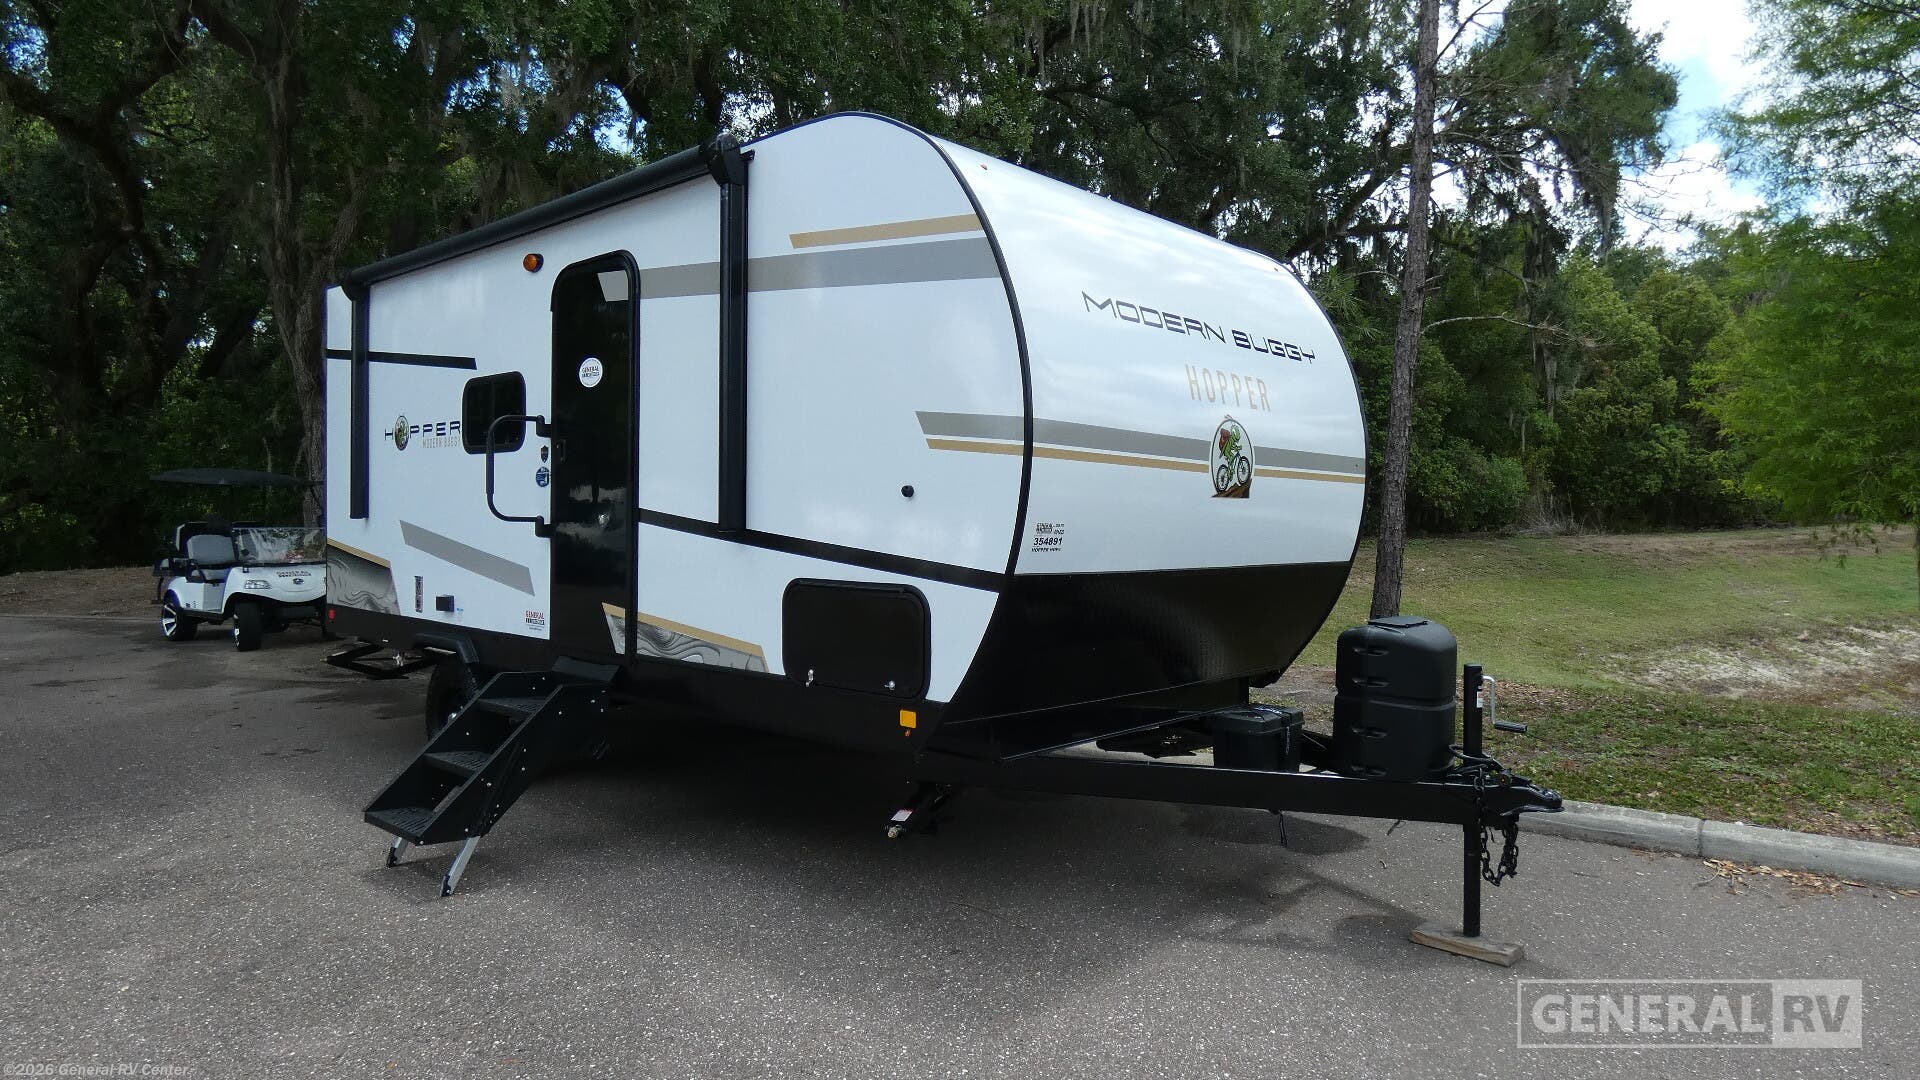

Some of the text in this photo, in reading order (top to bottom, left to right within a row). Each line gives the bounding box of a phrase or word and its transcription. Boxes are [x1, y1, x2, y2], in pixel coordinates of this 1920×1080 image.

[1081, 290, 1316, 364] MODERN BUGGY
[1185, 364, 1271, 412] HOPPER
[1033, 537, 1063, 546] 354891
